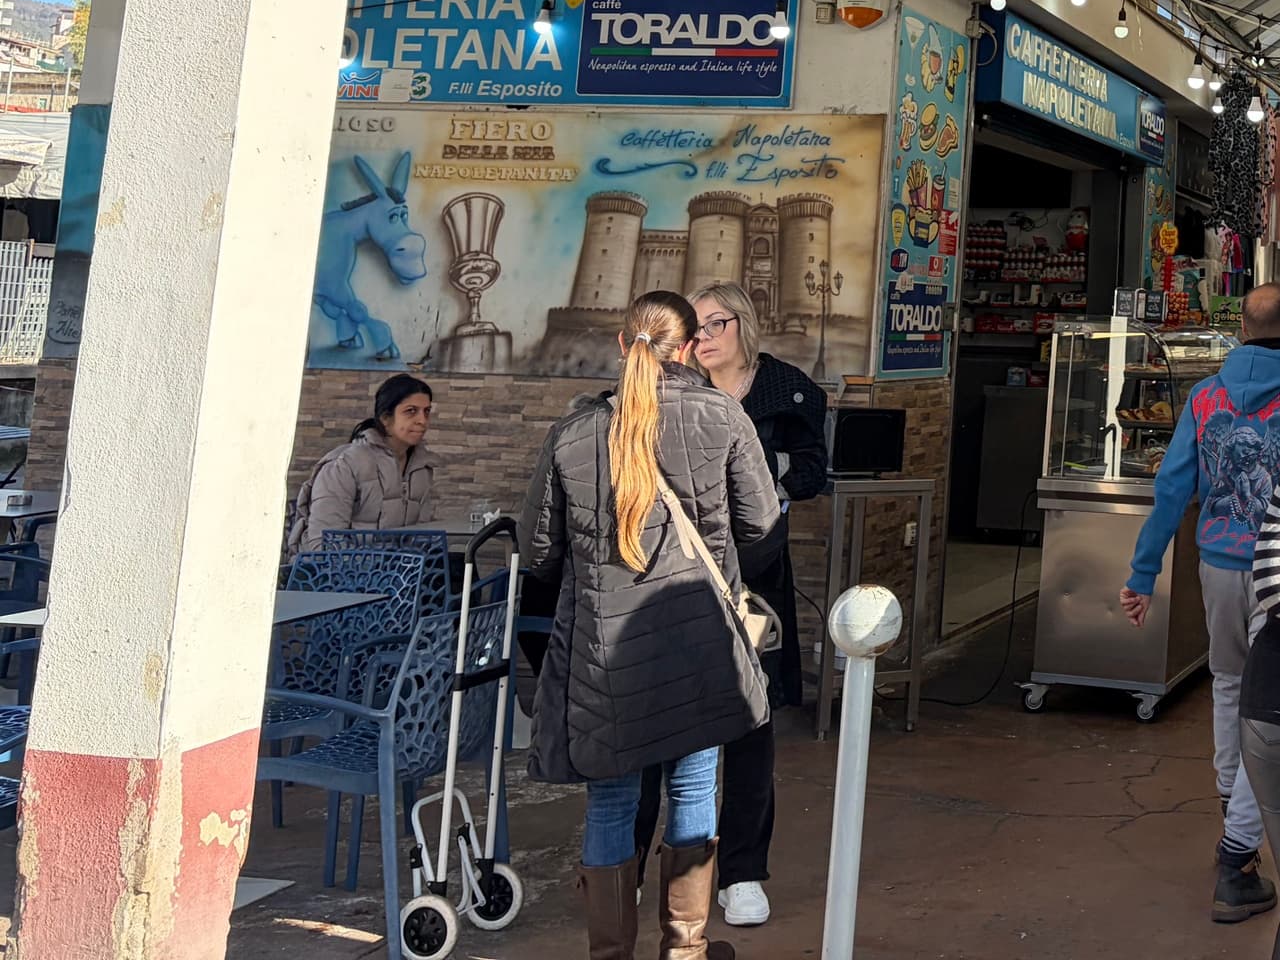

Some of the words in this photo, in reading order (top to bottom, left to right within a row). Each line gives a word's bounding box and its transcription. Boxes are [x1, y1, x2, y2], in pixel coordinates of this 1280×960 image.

[592, 0, 621, 9] caffè
[591, 12, 778, 47] TORALDO
[588, 59, 637, 72] Neapolitan
[640, 62, 676, 75] espresso
[679, 61, 698, 72] and
[700, 59, 733, 73] Italian
[736, 60, 753, 73] life
[755, 59, 777, 78] style
[1007, 23, 1108, 102] CAFFETTERIA
[477, 80, 563, 100] Esposito
[1022, 71, 1117, 139] NAPOLETANA
[450, 119, 552, 141] FIERO
[620, 128, 713, 149] Caffetteria
[732, 123, 832, 154] Napoletana
[736, 153, 846, 188] Esposito
[890, 303, 942, 332] TORALDO
